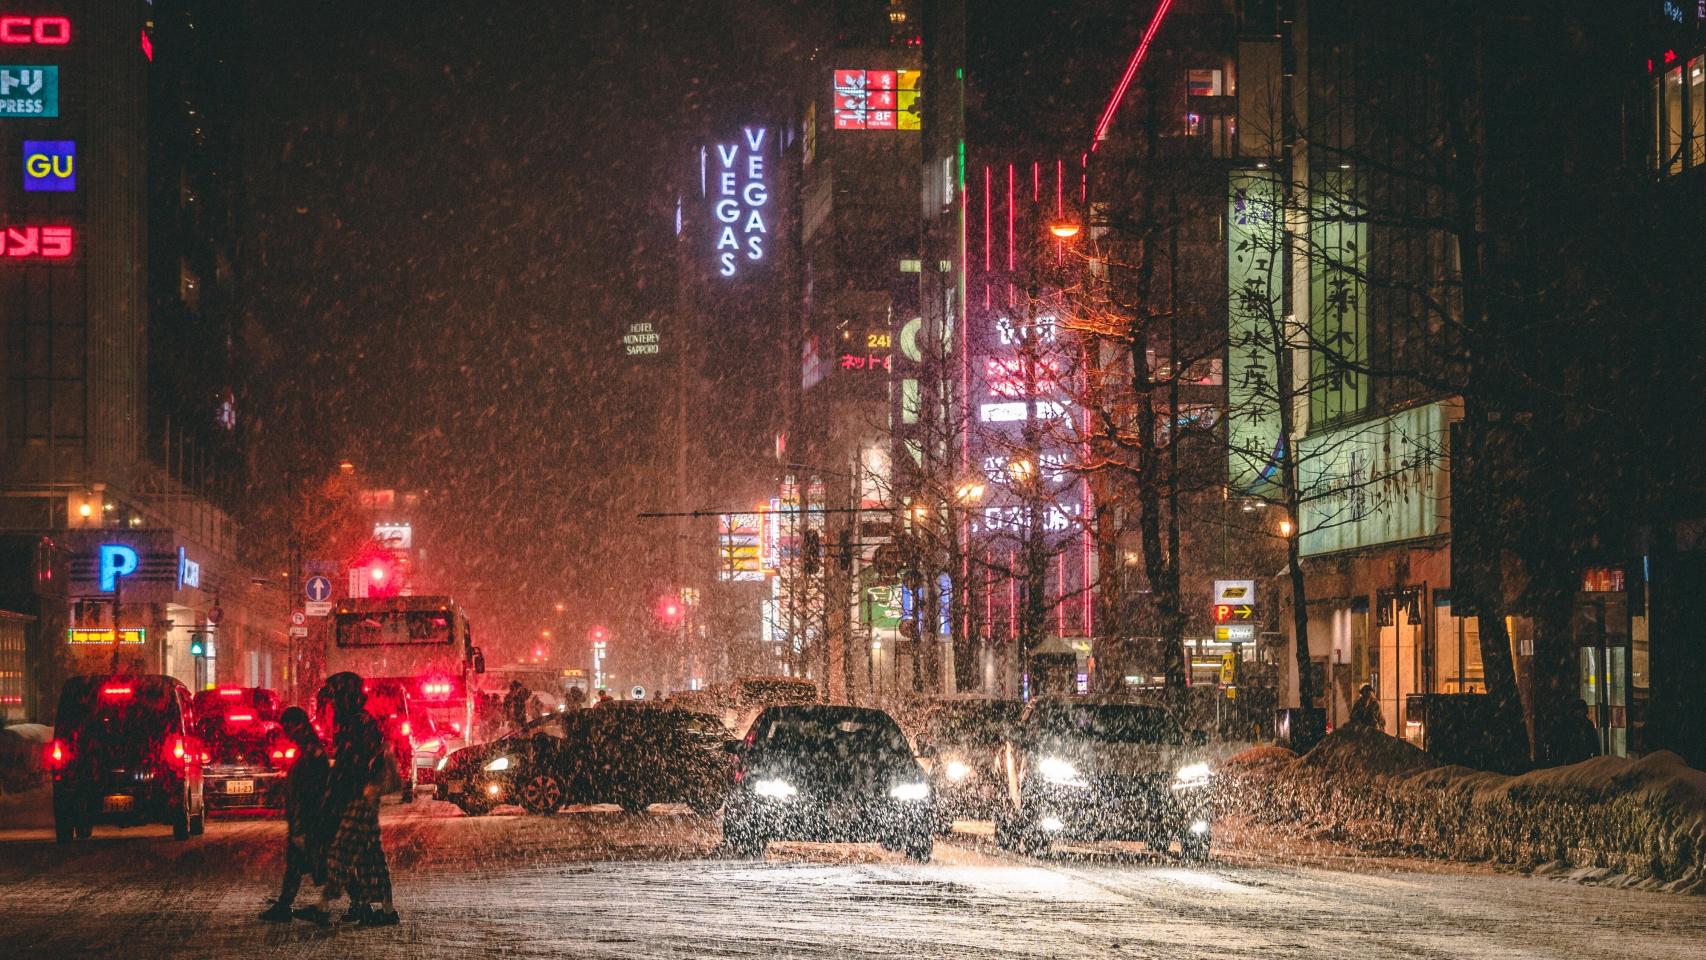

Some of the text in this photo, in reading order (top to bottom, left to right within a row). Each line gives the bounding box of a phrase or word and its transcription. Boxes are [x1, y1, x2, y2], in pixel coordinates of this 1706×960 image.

[1, 70, 43, 95] トリ
[875, 112, 891, 121] 8F
[26, 154, 73, 178] GU
[743, 128, 768, 260] VEGAS
[716, 144, 740, 276] VEGAS
[0, 226, 73, 256] メラ
[623, 334, 660, 344] MONTEREY
[630, 323, 653, 332] HOTEL
[626, 345, 659, 355] SAPPORO
[100, 545, 138, 592] P
[1218, 605, 1229, 620] P
